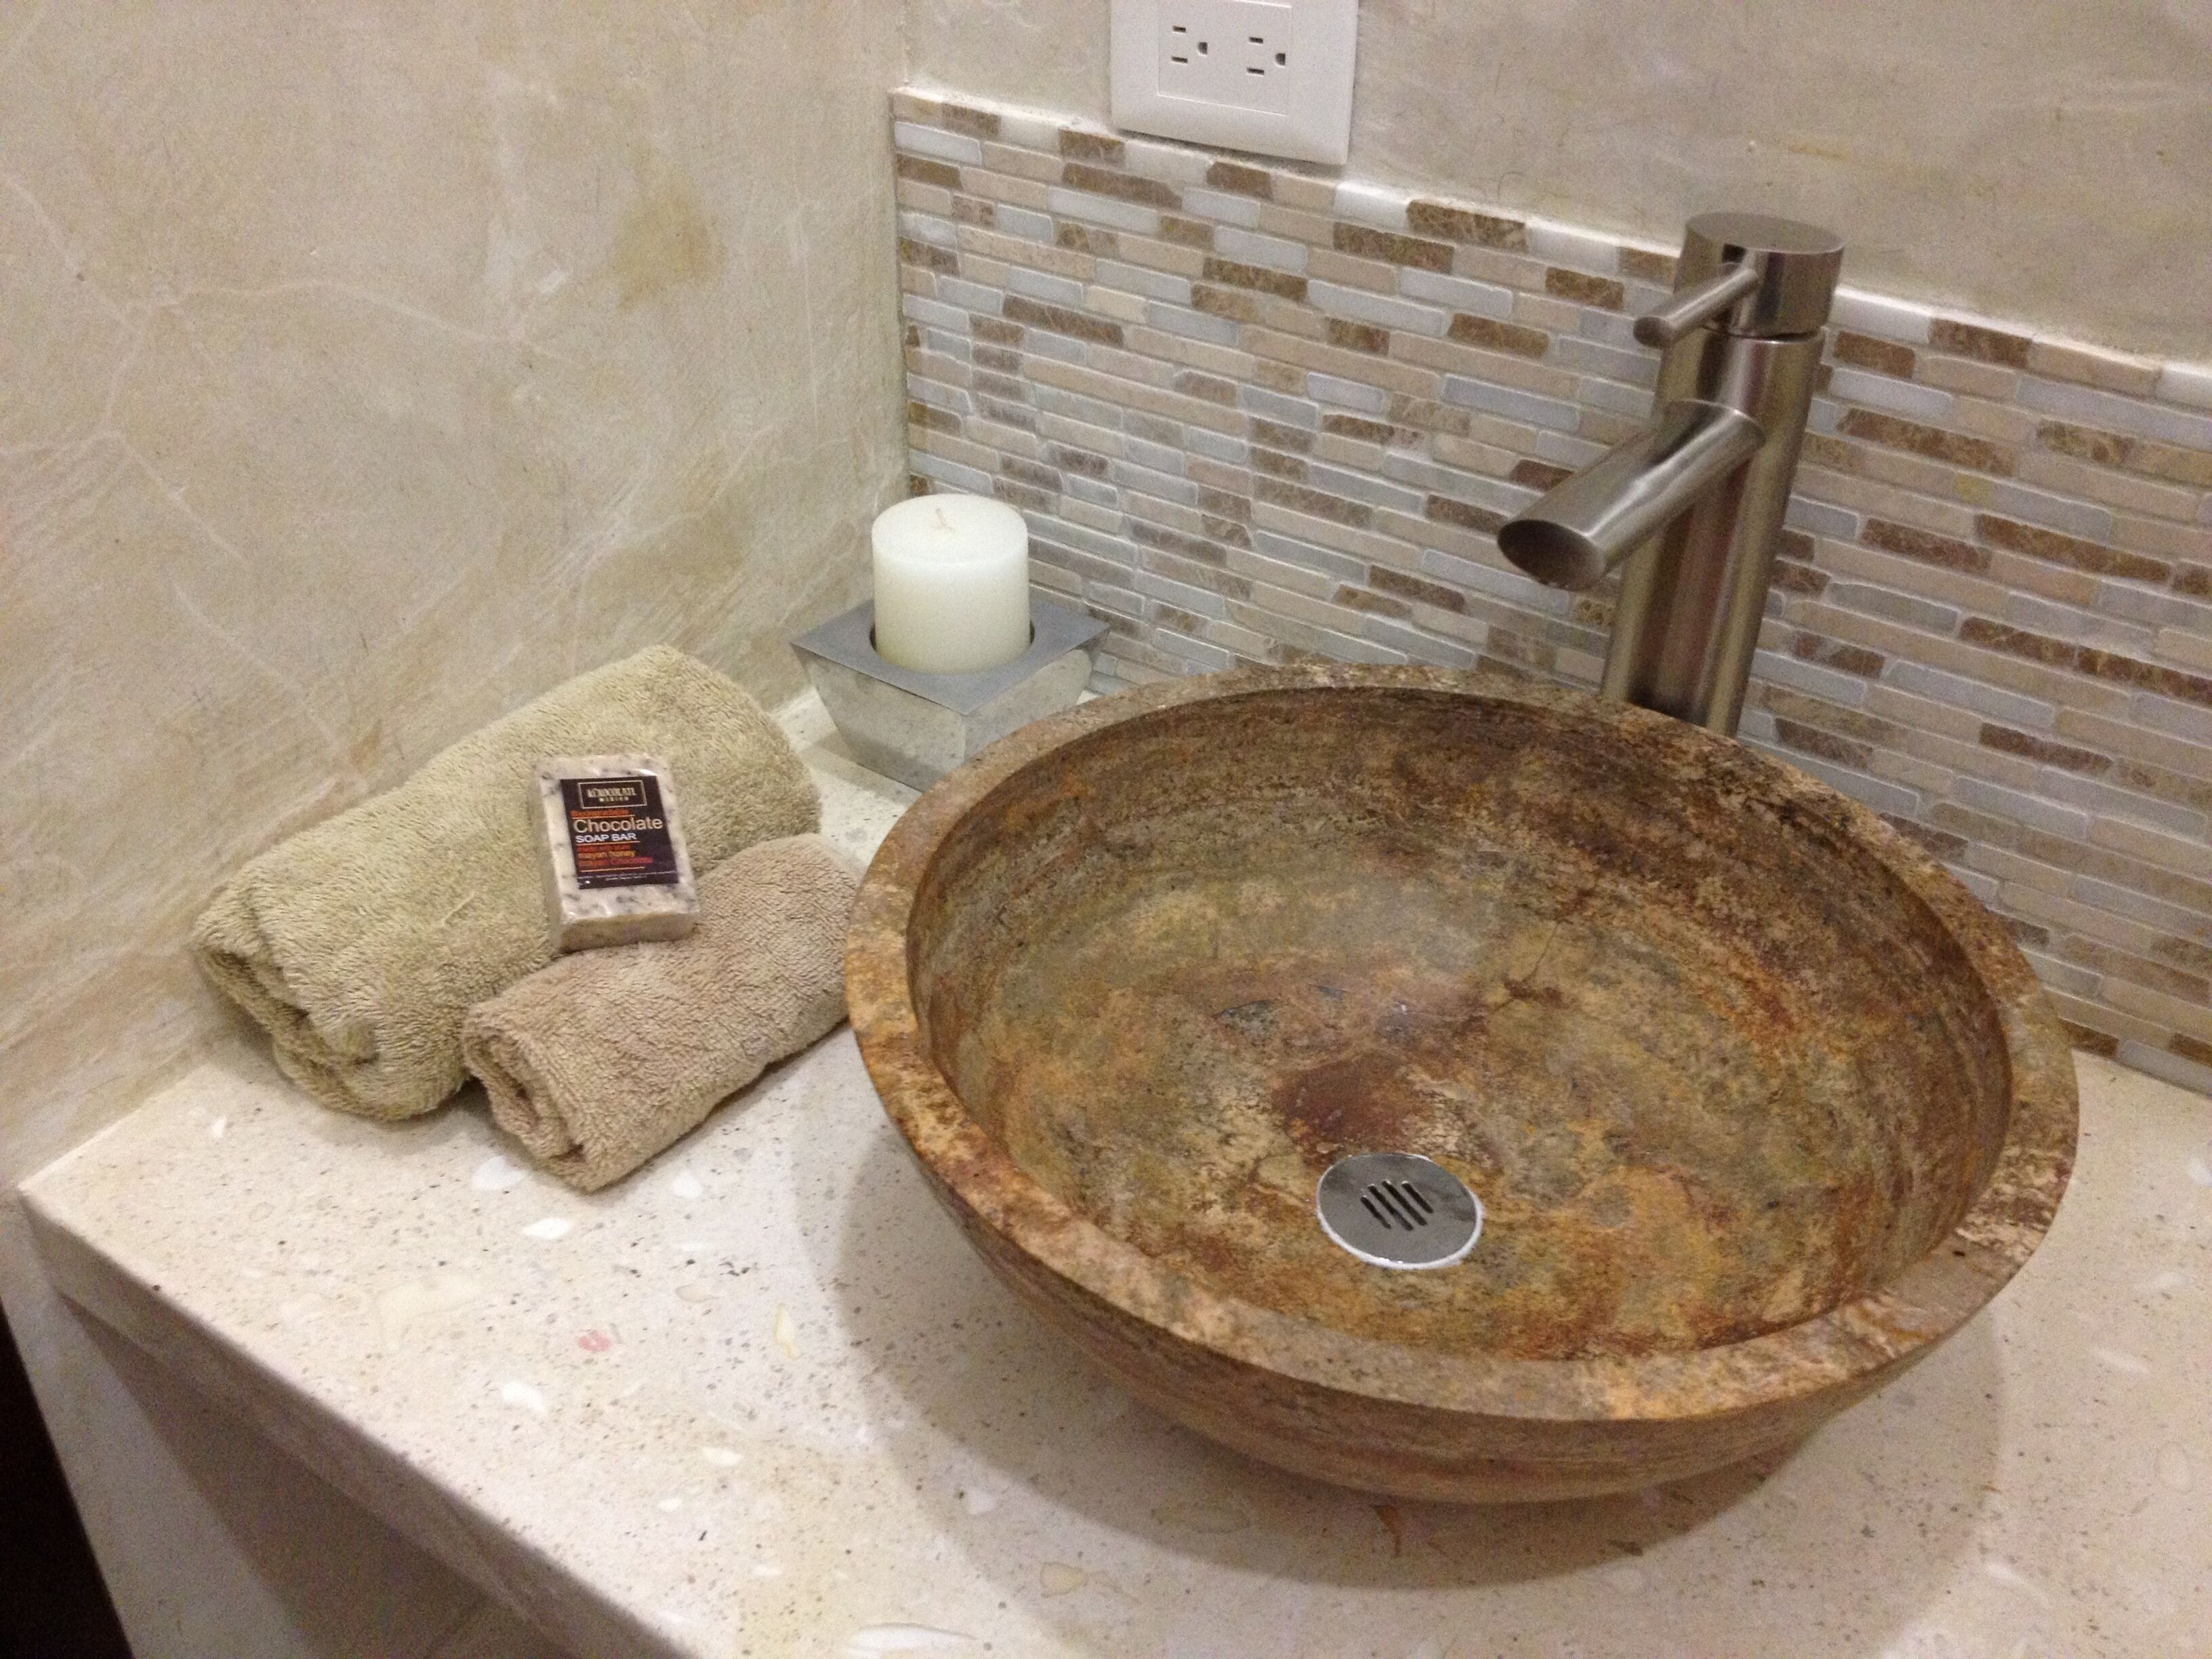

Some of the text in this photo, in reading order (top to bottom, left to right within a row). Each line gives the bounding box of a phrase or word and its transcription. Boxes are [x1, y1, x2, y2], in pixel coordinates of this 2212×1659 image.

[573, 816, 663, 833] Chocolate
[575, 833, 637, 843] SOAP BAR
